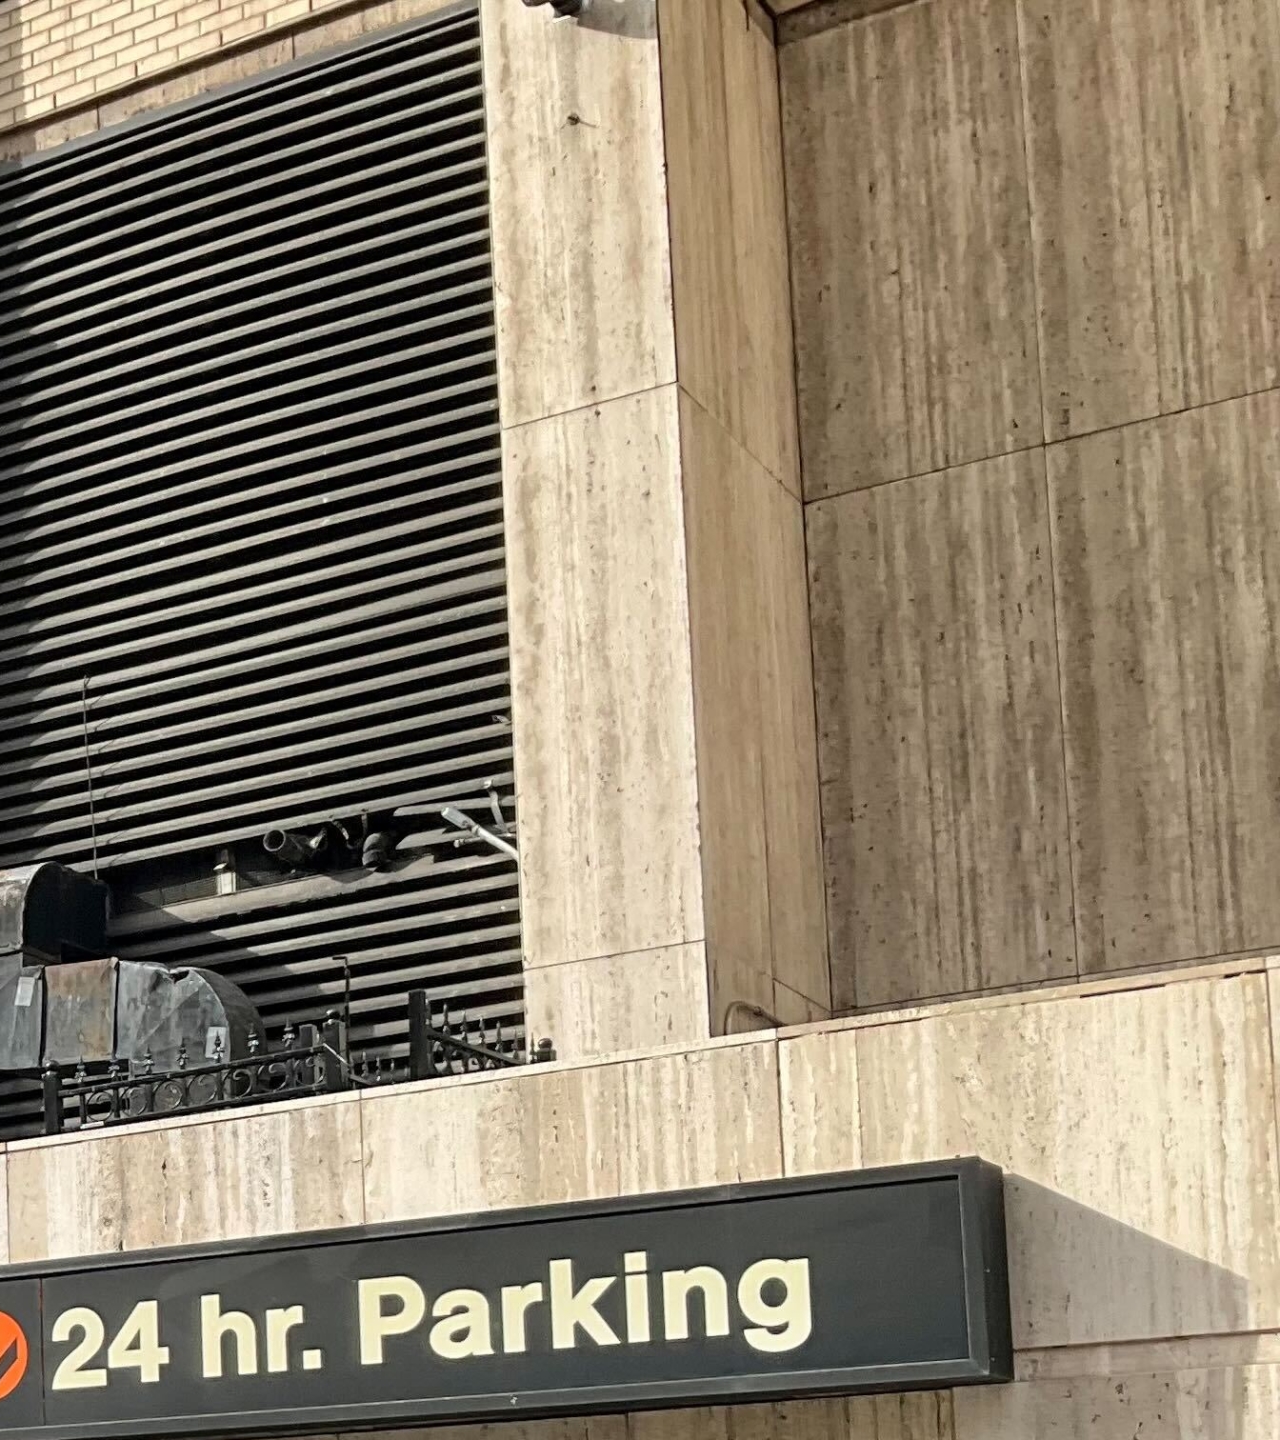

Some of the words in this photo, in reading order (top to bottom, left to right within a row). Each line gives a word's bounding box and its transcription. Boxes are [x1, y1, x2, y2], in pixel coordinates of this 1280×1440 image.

[50, 1305, 169, 1390] 24
[201, 1292, 324, 1377] hr.
[358, 1250, 811, 1366] Parking
